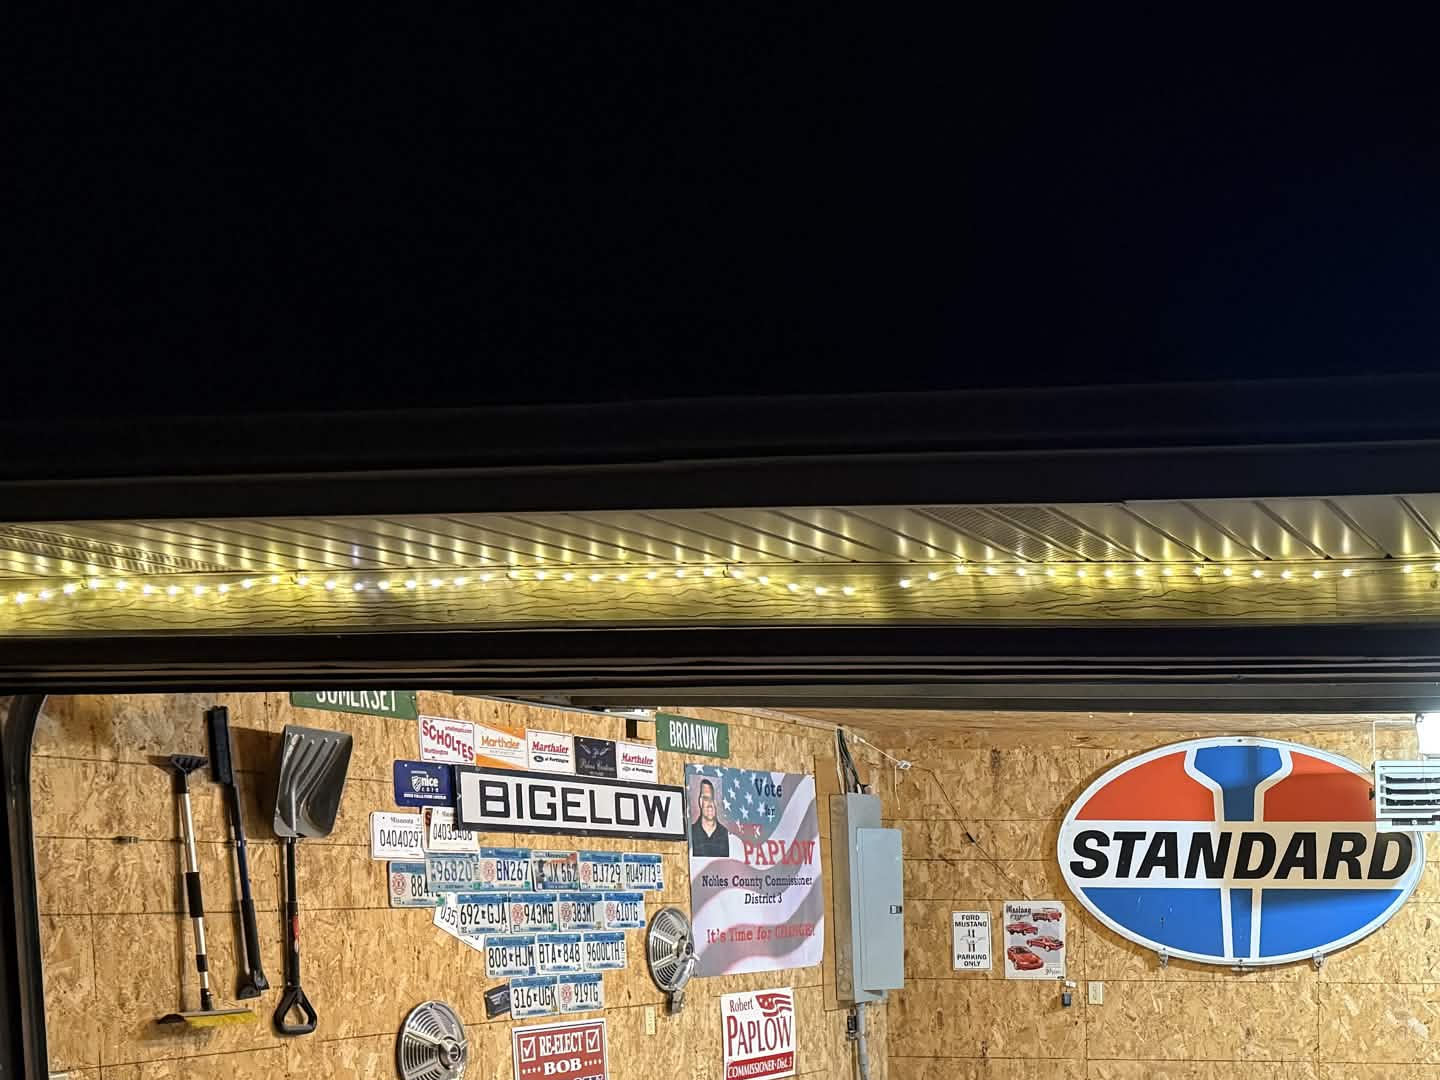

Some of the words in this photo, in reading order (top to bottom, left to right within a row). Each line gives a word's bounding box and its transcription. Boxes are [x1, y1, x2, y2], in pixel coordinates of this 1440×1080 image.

[422, 720, 474, 761] SCHOLTES
[669, 720, 719, 753] BROADWAY
[532, 741, 569, 754] Marthaler
[622, 752, 654, 765] Marthaler
[755, 778, 782, 798] Vote
[479, 780, 672, 828] BIGELOW
[743, 839, 816, 865] PAPLOW
[1070, 829, 1413, 880] STANDARD
[496, 860, 529, 881] BN267
[702, 875, 728, 887] Nobles
[732, 875, 763, 889] County
[744, 893, 776, 904] District
[777, 893, 783, 903] 3
[727, 927, 753, 941] Time
[957, 953, 987, 961] PARKING
[513, 988, 532, 1009] 316
[729, 997, 754, 1012] Robert
[726, 1015, 792, 1057] PAPLOW
[543, 1057, 582, 1075] BOB
